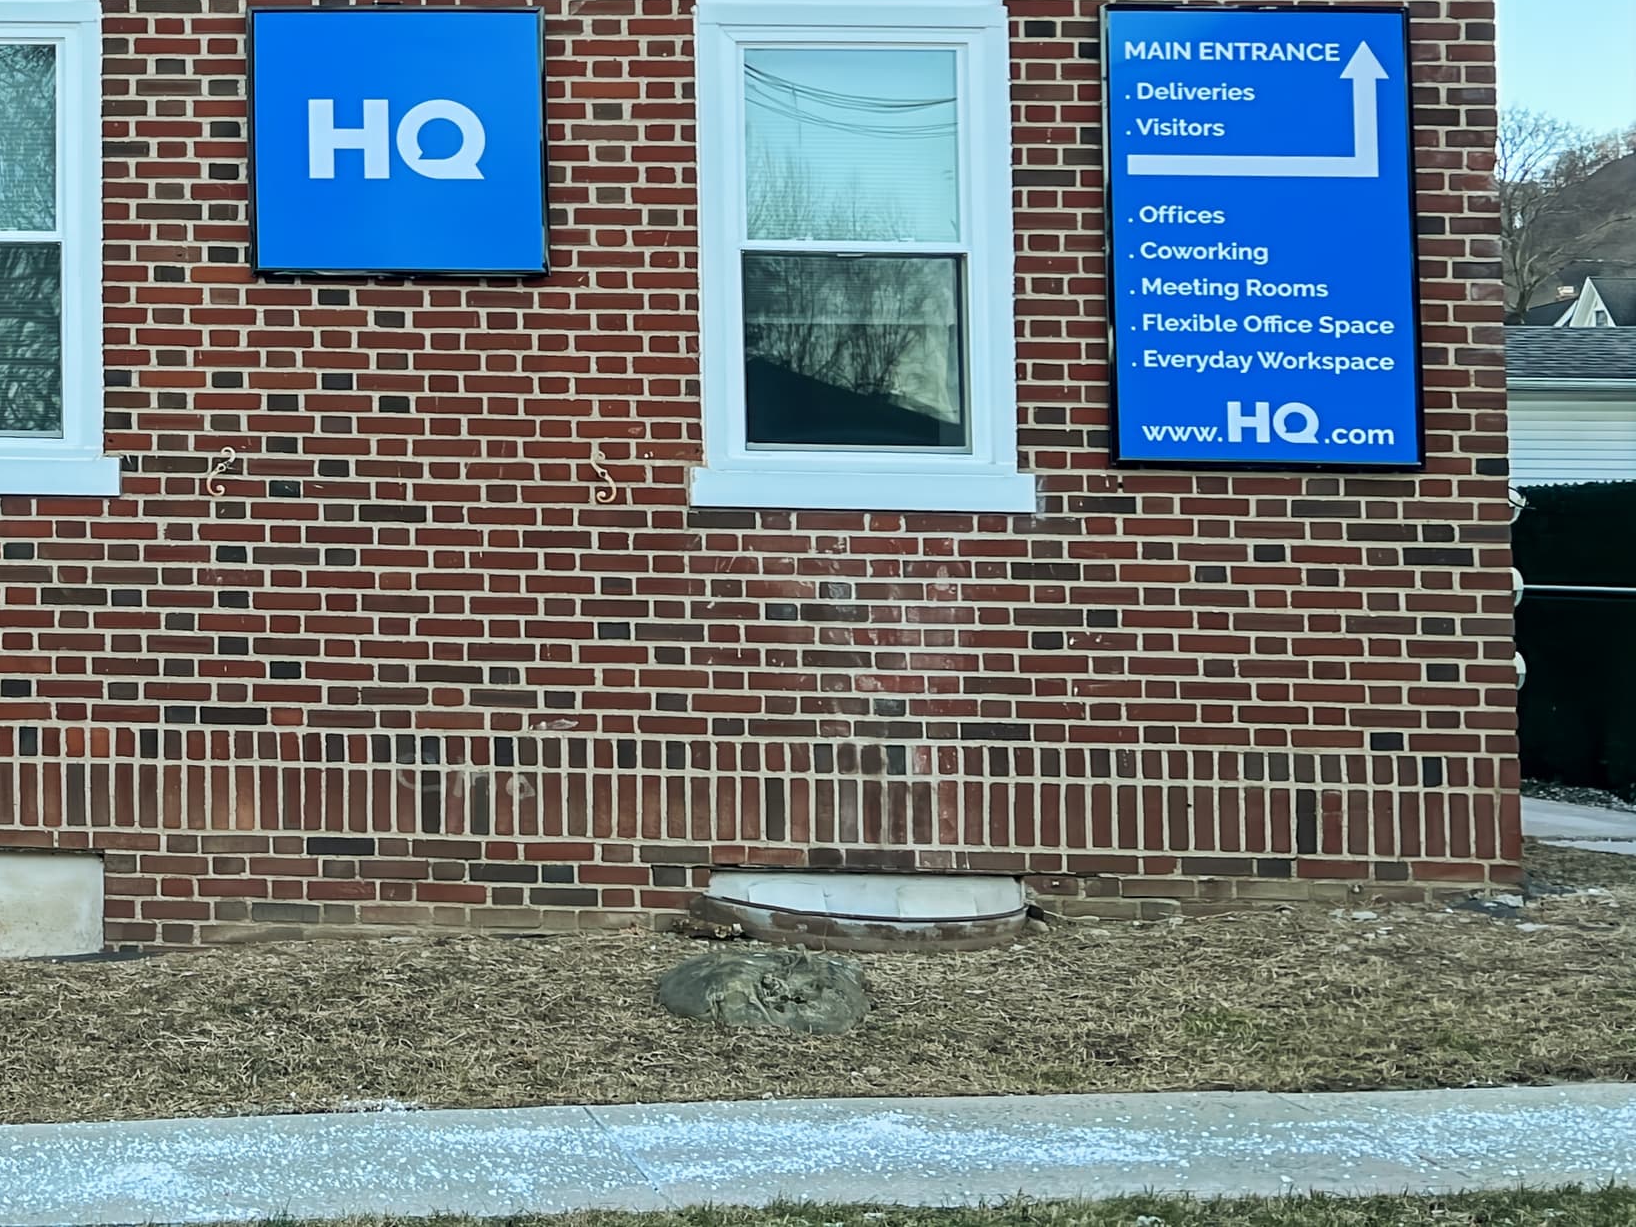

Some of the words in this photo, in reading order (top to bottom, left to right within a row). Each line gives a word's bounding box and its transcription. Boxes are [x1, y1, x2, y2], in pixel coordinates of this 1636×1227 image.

[1124, 40, 1191, 61] MAIN
[1198, 41, 1341, 62] ENTRANCE
[1137, 81, 1255, 102] Deliveries
[308, 99, 486, 180] HQ
[1136, 117, 1225, 137] Visitors
[1139, 204, 1226, 224] Offices
[1140, 240, 1269, 266] Coworking
[1141, 276, 1240, 301] Meeting
[1246, 278, 1329, 298] Rooms
[1142, 312, 1238, 334] Flexible
[1243, 314, 1313, 334] Office
[1319, 315, 1395, 340] Space
[1143, 348, 1253, 375] Everyday
[1257, 351, 1395, 376] Workspace
